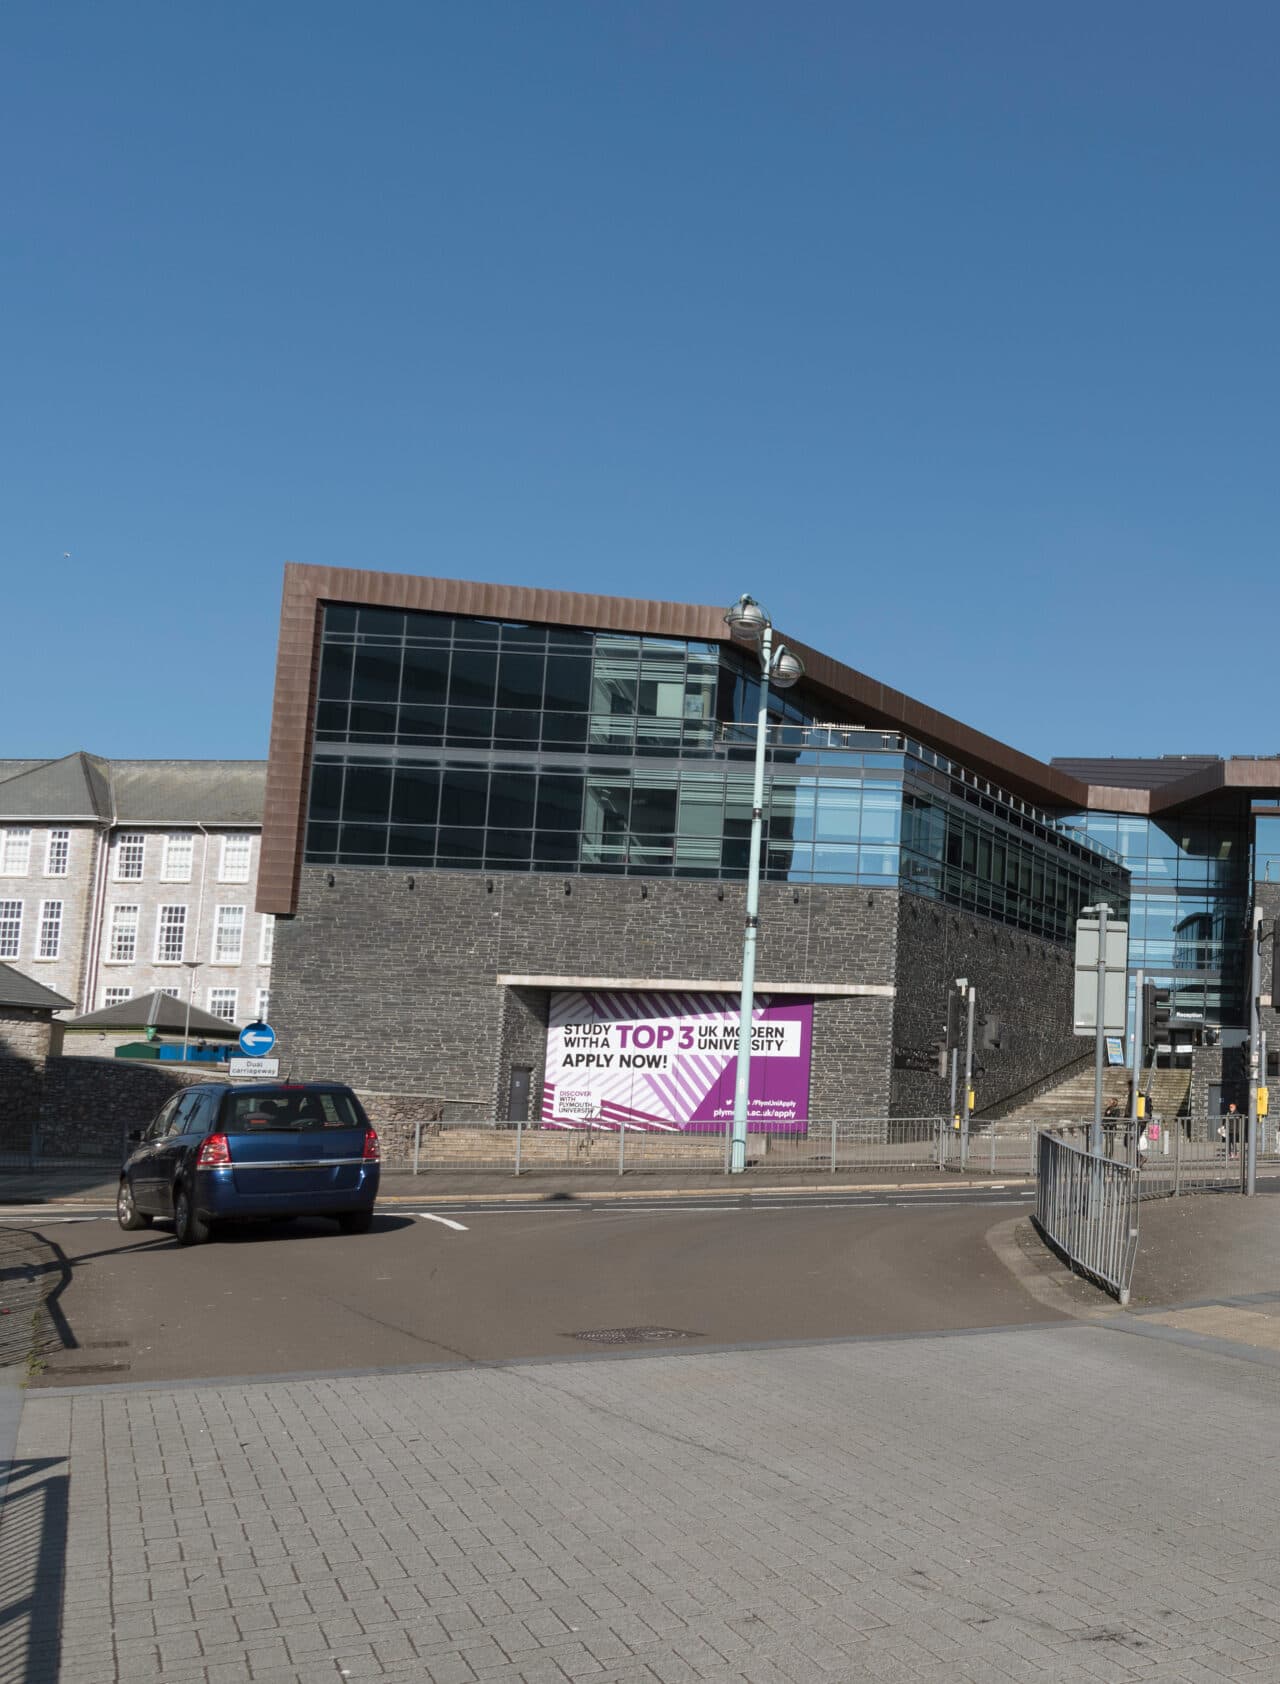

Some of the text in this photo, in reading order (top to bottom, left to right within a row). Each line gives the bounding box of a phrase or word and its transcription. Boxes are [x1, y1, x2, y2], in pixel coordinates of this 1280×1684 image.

[564, 1023, 611, 1036] STUDY
[698, 1025, 718, 1038] UK
[564, 1037, 611, 1048] WITH A
[616, 1025, 695, 1050] TOP 3
[698, 1039, 784, 1051] UNIVESITY
[562, 1053, 668, 1069] APPLY NOW!
